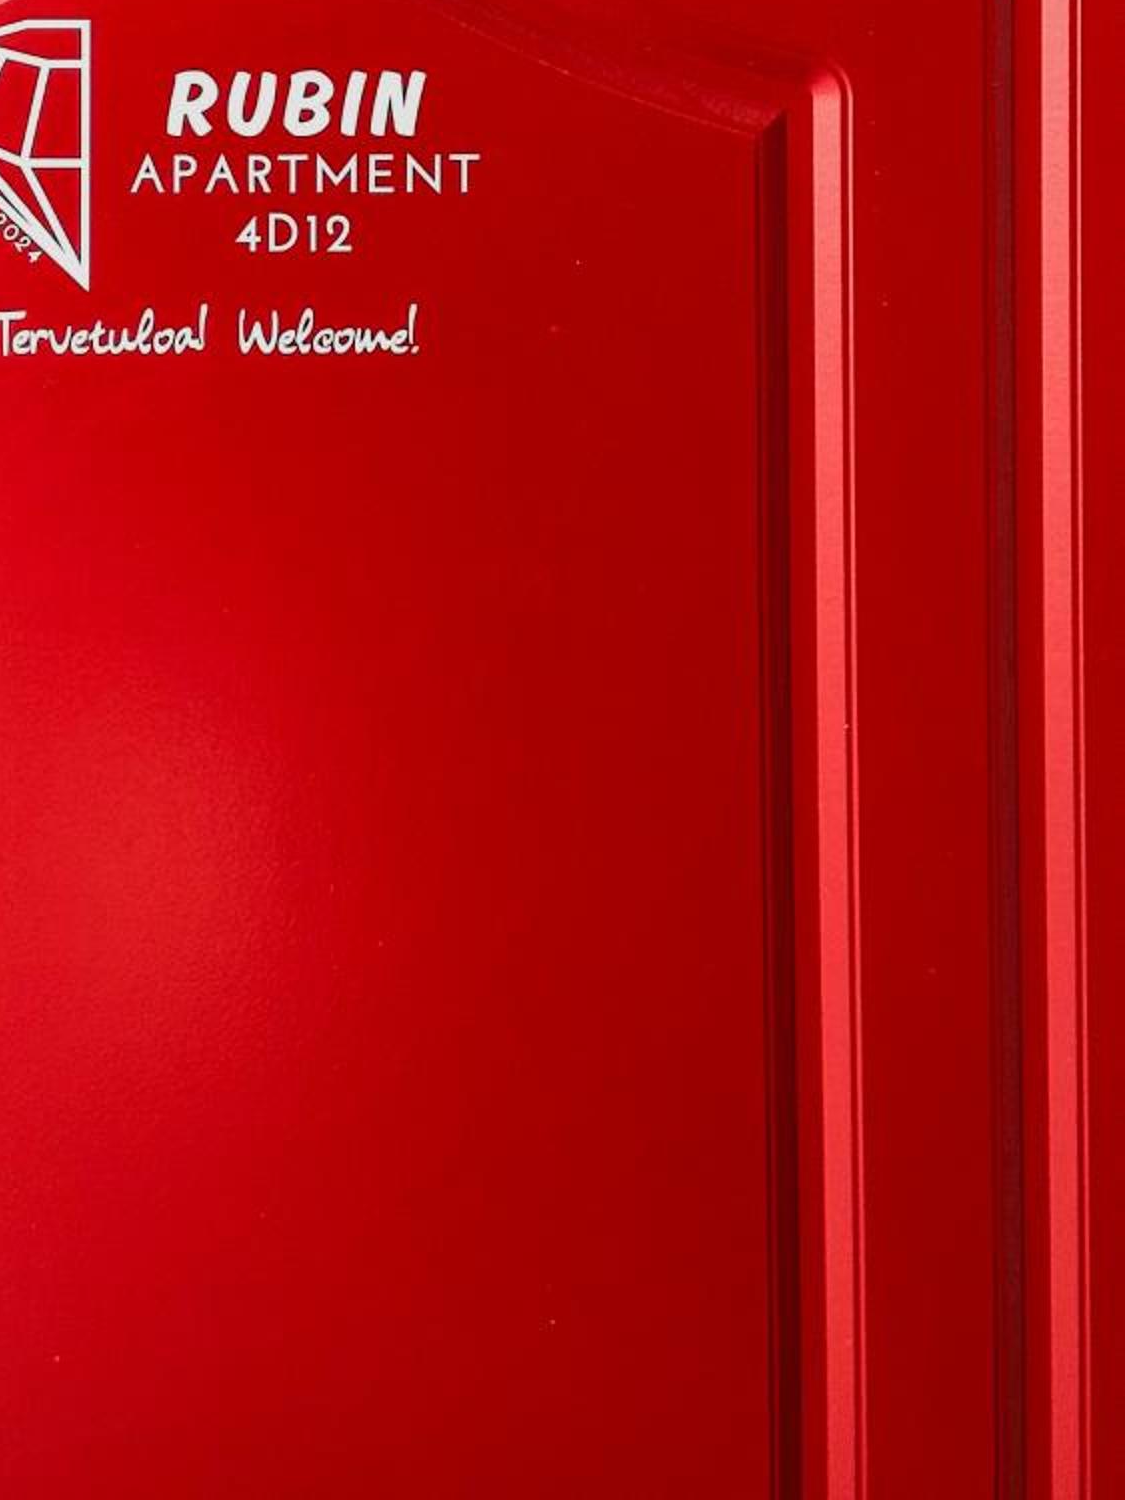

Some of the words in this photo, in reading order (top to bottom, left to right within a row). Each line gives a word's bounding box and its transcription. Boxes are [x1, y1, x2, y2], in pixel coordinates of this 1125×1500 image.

[166, 69, 427, 137] RUBIN
[130, 153, 481, 194] APARTMENT
[235, 212, 352, 253] 4D12
[238, 303, 420, 355] Welcome!
